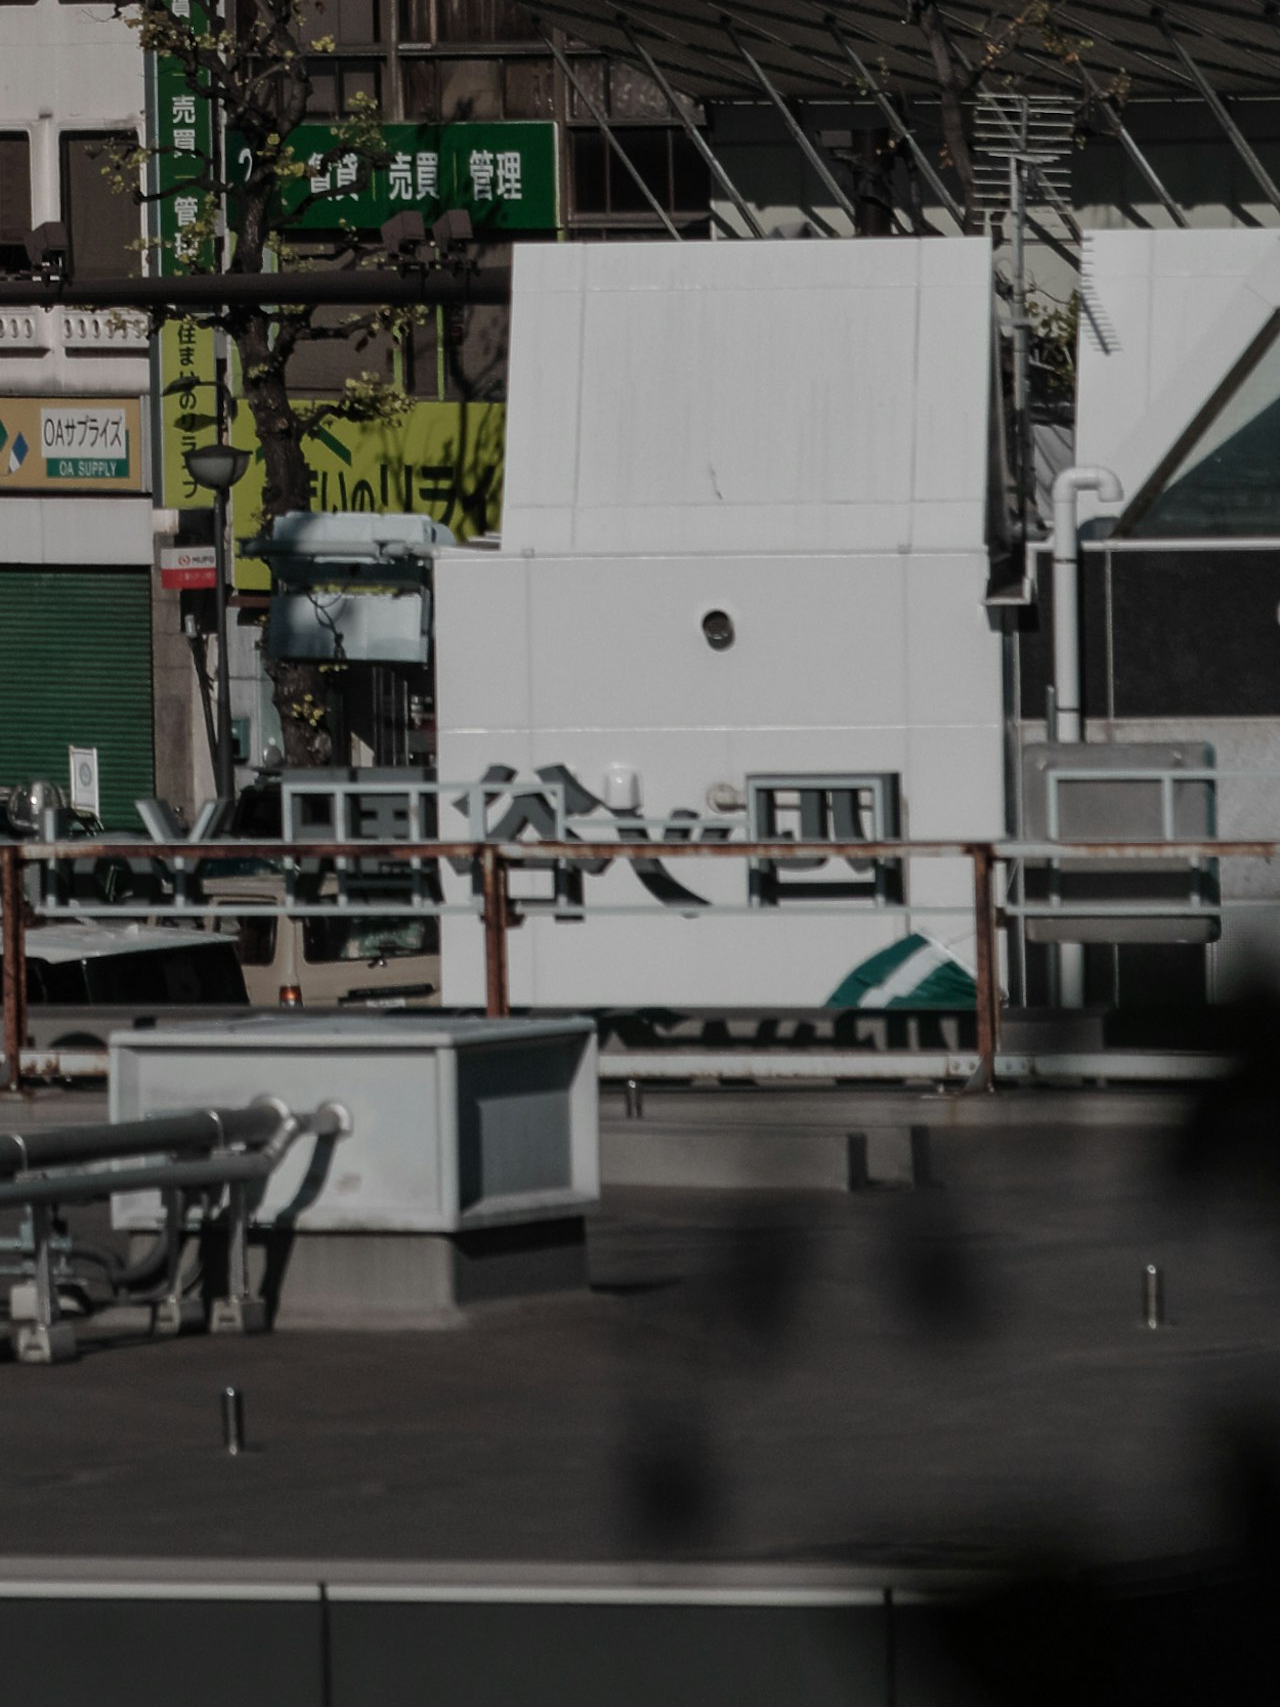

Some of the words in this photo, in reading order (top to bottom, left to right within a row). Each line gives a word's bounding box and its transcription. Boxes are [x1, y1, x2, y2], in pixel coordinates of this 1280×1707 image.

[172, 94, 196, 159] 売買
[389, 150, 440, 201] 売買
[468, 149, 523, 201] 管理
[178, 323, 198, 499] 住まのリラフ
[59, 462, 74, 477] OA
[78, 462, 118, 477] SUPPLY
